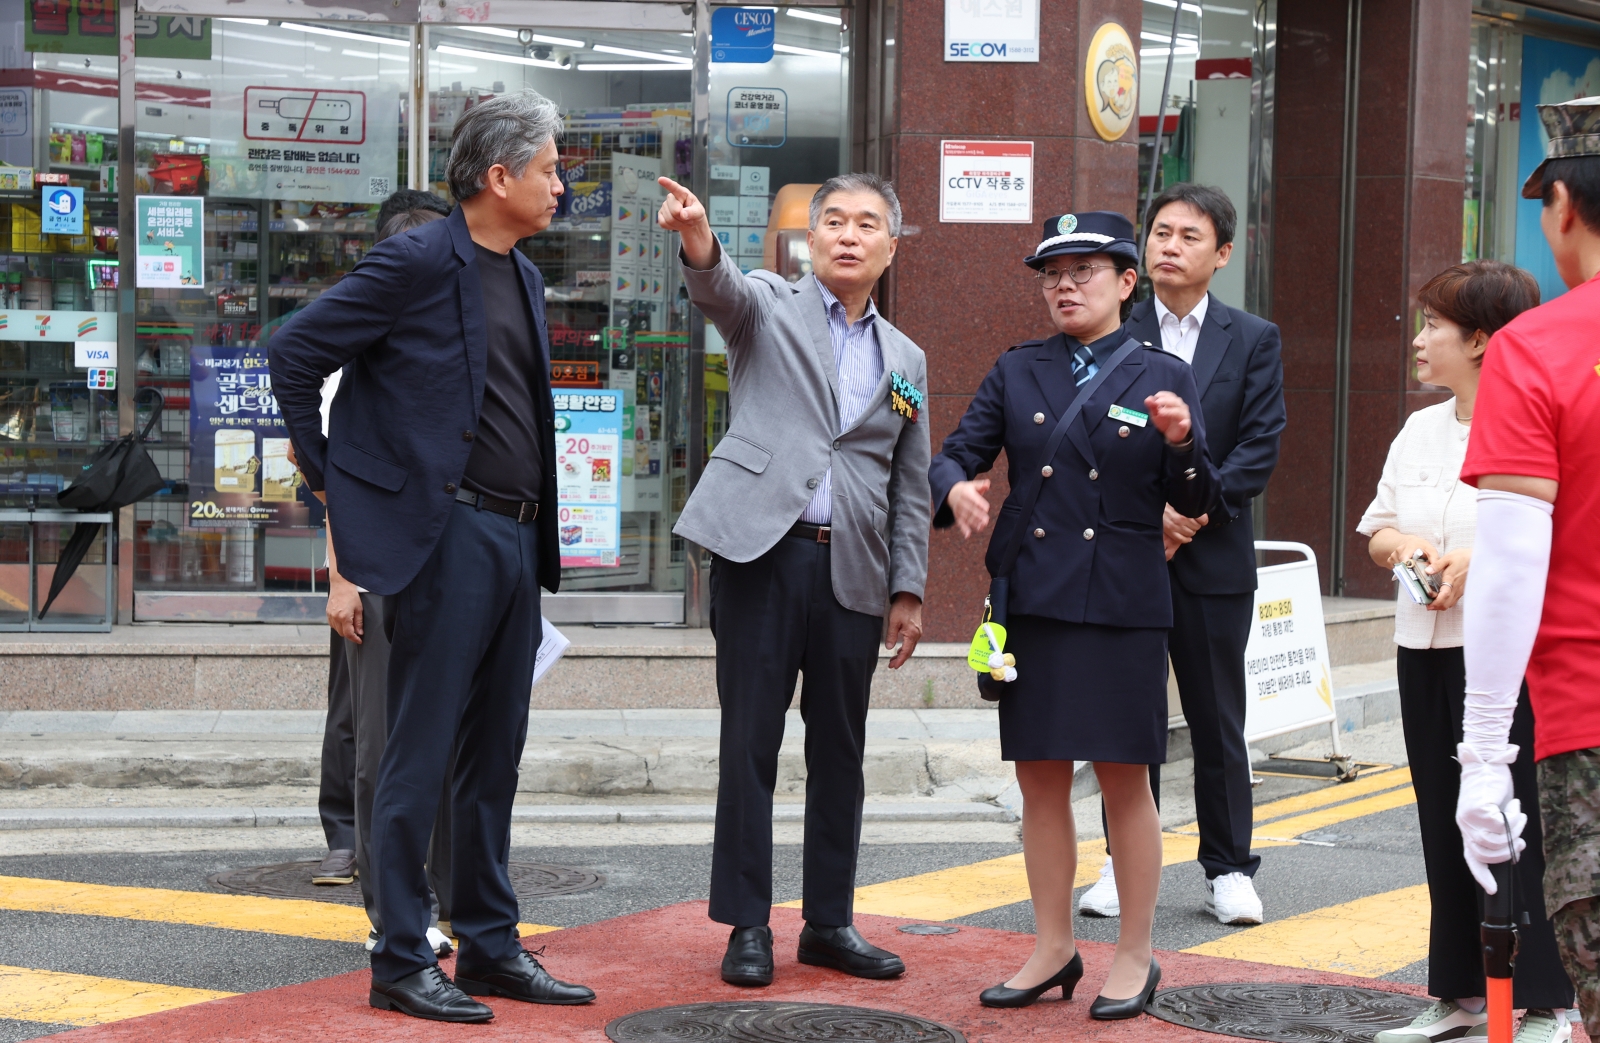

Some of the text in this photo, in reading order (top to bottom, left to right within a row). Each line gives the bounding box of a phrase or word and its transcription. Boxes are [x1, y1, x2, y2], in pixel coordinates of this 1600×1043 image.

[734, 12, 771, 25] CESCO
[950, 42, 1006, 57] SECOM
[740, 93, 774, 101] 건강먹거리
[248, 148, 360, 164] 괜찮은 담배는 없습니다
[248, 164, 268, 172] 흡연은
[306, 166, 326, 174] 금연은
[328, 166, 360, 175] 1544-9030
[637, 169, 656, 181] CARD
[948, 176, 1025, 190] CCTV 작동중
[571, 190, 604, 214] Cass
[147, 206, 193, 217] 세븐일레븐
[147, 217, 193, 227] 온라인주문
[157, 227, 184, 237] 서비스
[552, 330, 597, 346] 편의점
[86, 350, 109, 359] VISA
[205, 358, 242, 369] 비교불가,
[90, 370, 115, 387] JCB
[214, 395, 280, 415] 샌드위
[554, 394, 616, 412] 생활안정
[566, 438, 590, 454] 20
[192, 501, 225, 518] 20%
[1260, 604, 1272, 619] 8:20
[1279, 601, 1292, 616] 8:50
[1262, 620, 1294, 638] 차량 통행 제한
[1247, 646, 1316, 675] 어린이의 안전한 통학을 위해
[1258, 670, 1312, 696] 30분만 배려해 주세요
